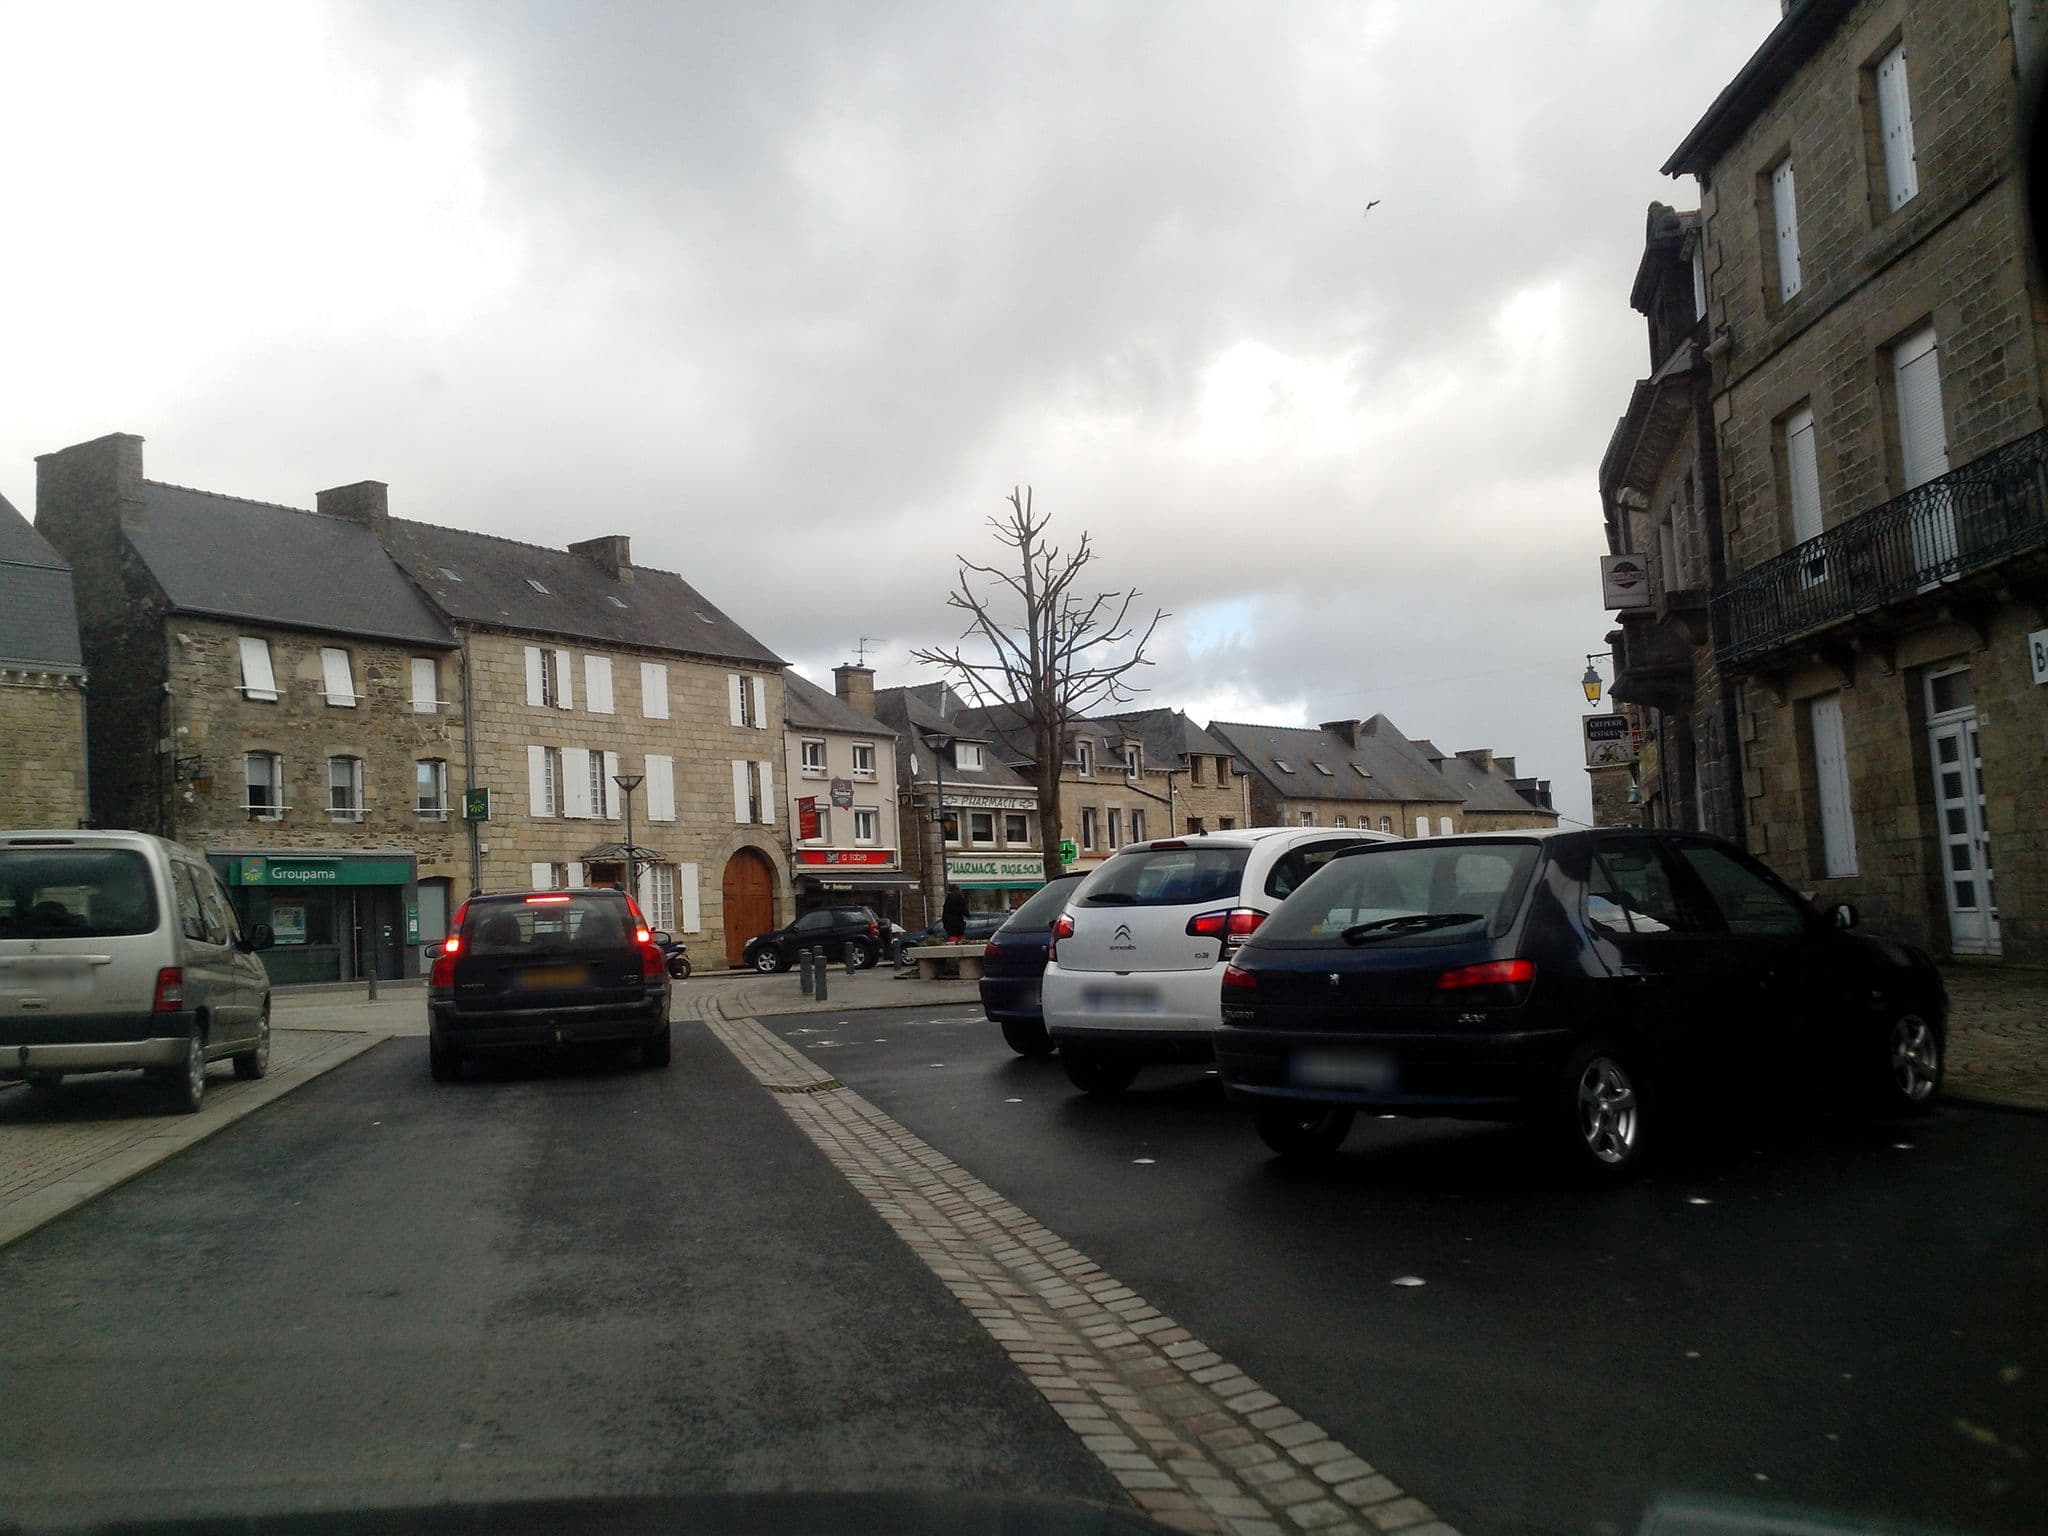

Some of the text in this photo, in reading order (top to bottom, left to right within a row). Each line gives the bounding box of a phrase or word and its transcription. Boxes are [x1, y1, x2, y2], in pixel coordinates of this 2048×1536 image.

[2035, 642, 2048, 673] B
[272, 867, 336, 882] Groupama
[944, 863, 998, 875] PHARMACIE
